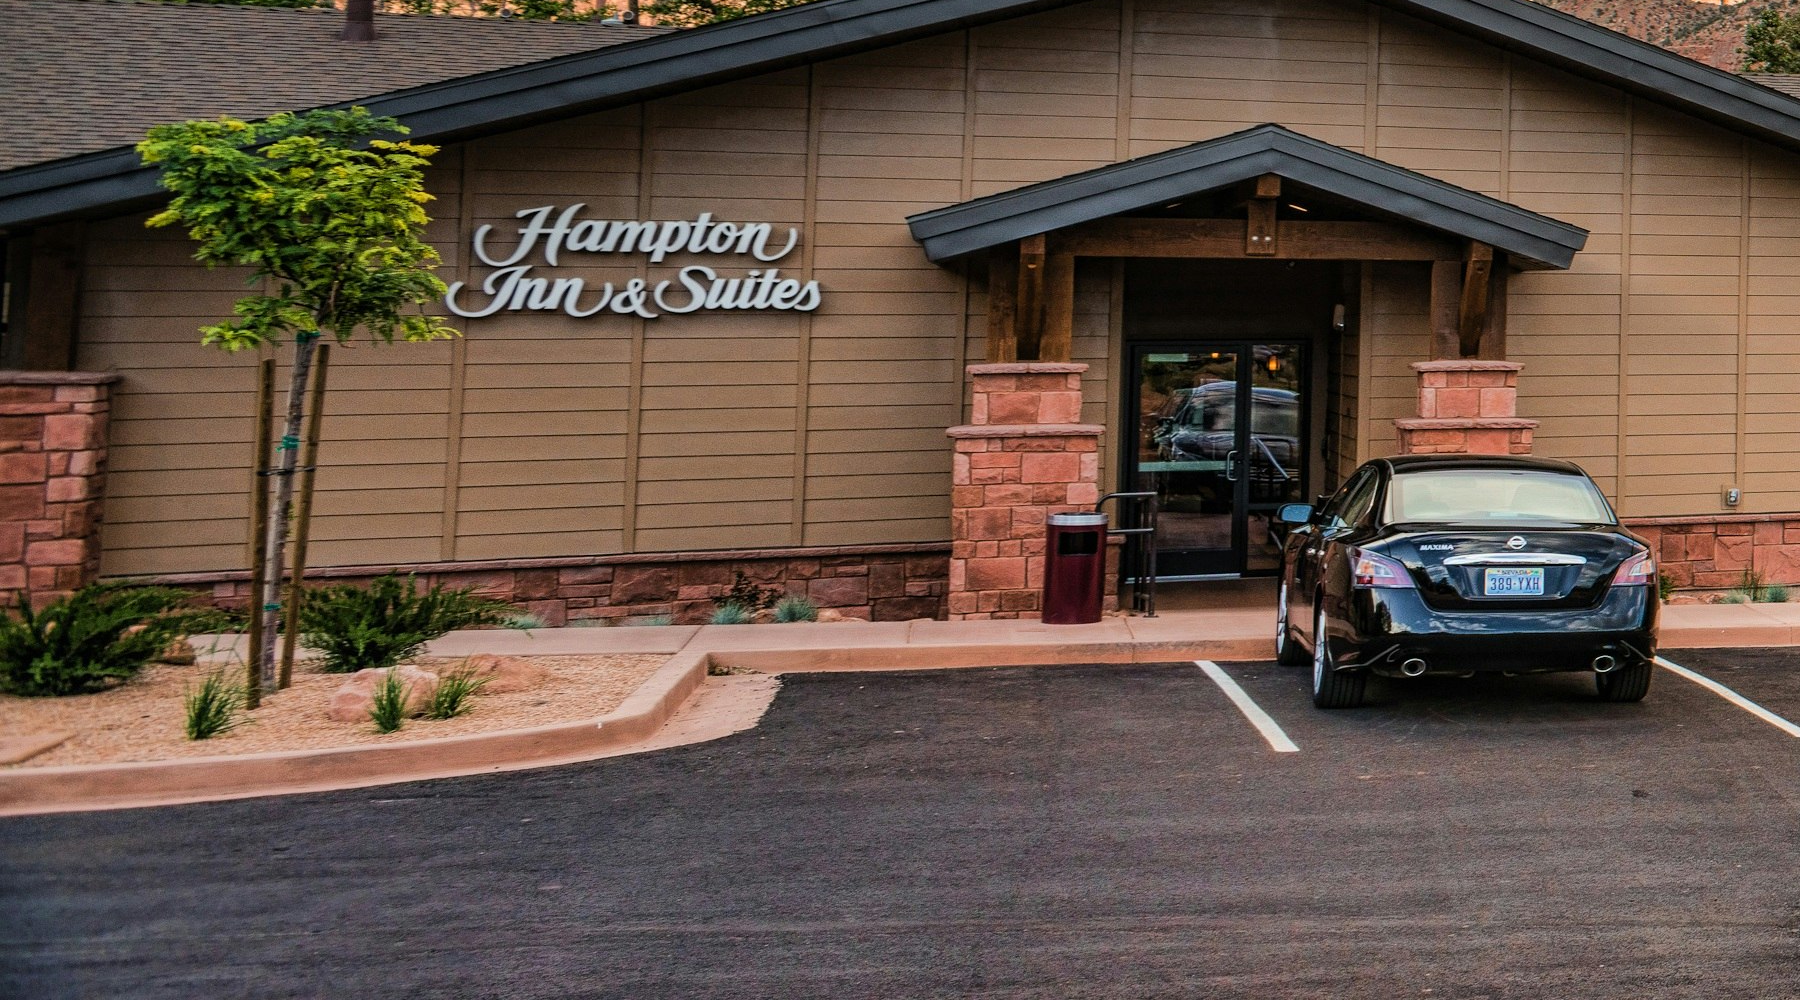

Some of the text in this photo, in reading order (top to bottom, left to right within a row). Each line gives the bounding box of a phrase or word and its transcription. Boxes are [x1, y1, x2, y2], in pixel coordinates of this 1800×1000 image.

[474, 203, 798, 267] Hampton
[446, 265, 821, 319] Inn & Suites
